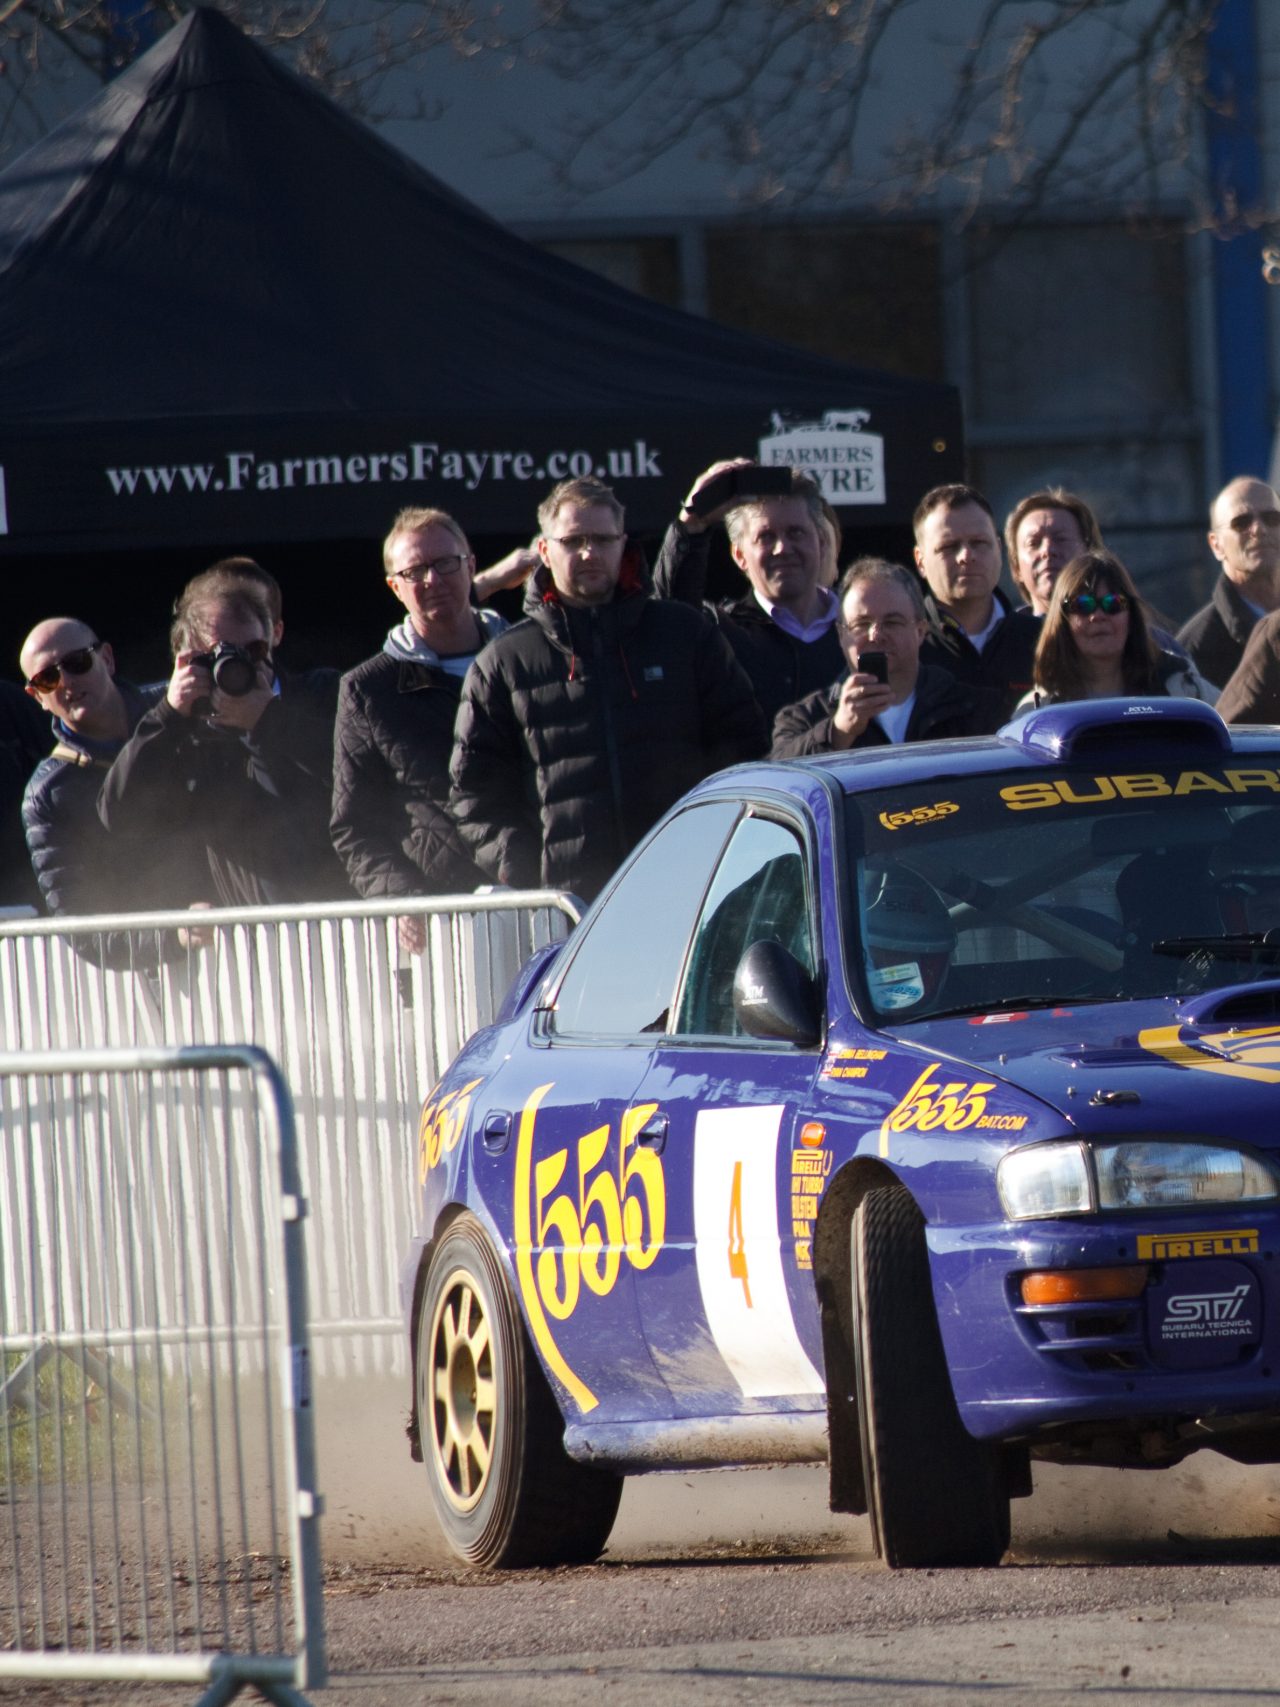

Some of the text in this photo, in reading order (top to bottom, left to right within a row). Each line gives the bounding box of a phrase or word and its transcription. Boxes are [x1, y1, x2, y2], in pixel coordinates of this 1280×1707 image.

[106, 440, 664, 496] www.FarmersFayre.co.uk
[771, 446, 874, 465] FARMERS
[806, 467, 877, 492] YRE
[975, 1115, 1028, 1131] BAT.COM
[791, 1149, 824, 1175] PIRELLI
[728, 1161, 753, 1309] 4
[1137, 1229, 1259, 1260] PIRELLI
[1161, 1320, 1253, 1332] SUBARU TECNICA
[1161, 1328, 1253, 1340] INTERNATIONAL
